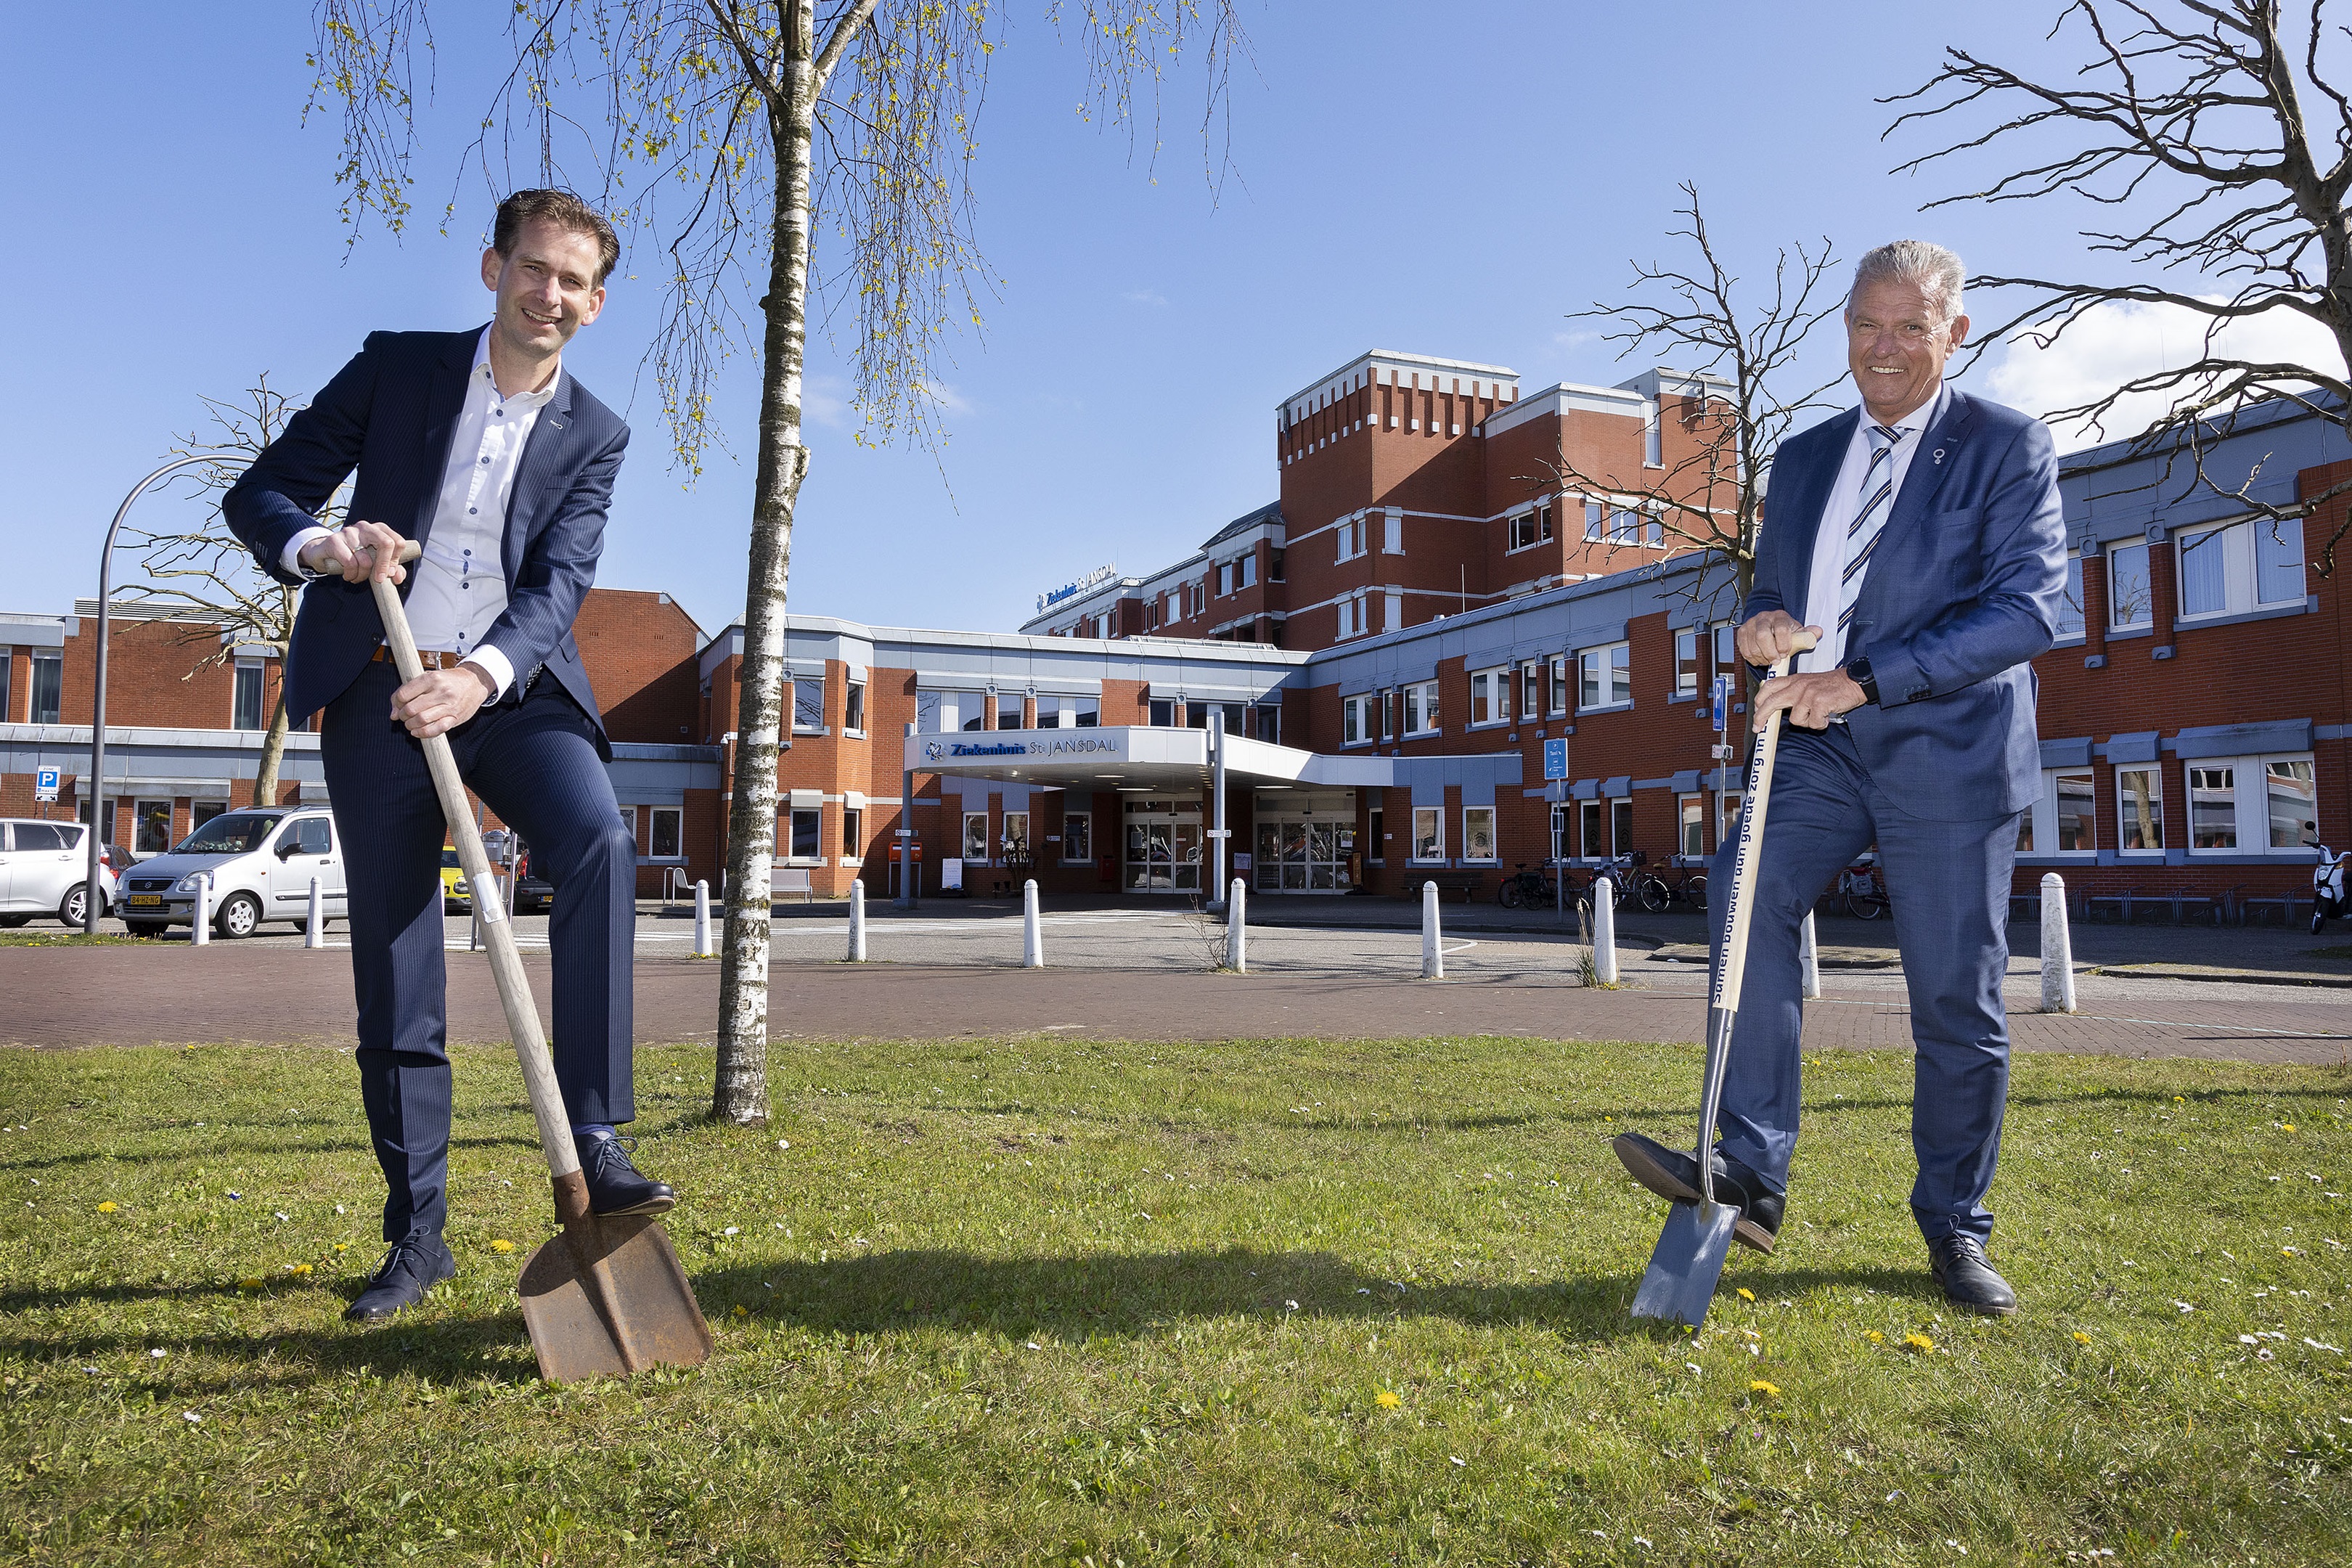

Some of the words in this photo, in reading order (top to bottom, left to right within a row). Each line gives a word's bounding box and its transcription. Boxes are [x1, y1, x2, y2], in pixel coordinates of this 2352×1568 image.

[1047, 582, 1077, 605] Ziekenhuis
[1085, 562, 1119, 593] JANSDAL
[1715, 682, 1722, 709] P
[950, 743, 1026, 757] Ziekenhuis
[1029, 741, 1044, 755] St
[1048, 739, 1118, 757] JANSDAL
[1755, 738, 1765, 753] in
[41, 772, 54, 786] P
[1749, 757, 1765, 791] zorg
[1741, 796, 1756, 843] goede
[1735, 847, 1747, 877] aan
[1723, 881, 1741, 944] bouwen
[1713, 947, 1729, 1004] Samen
